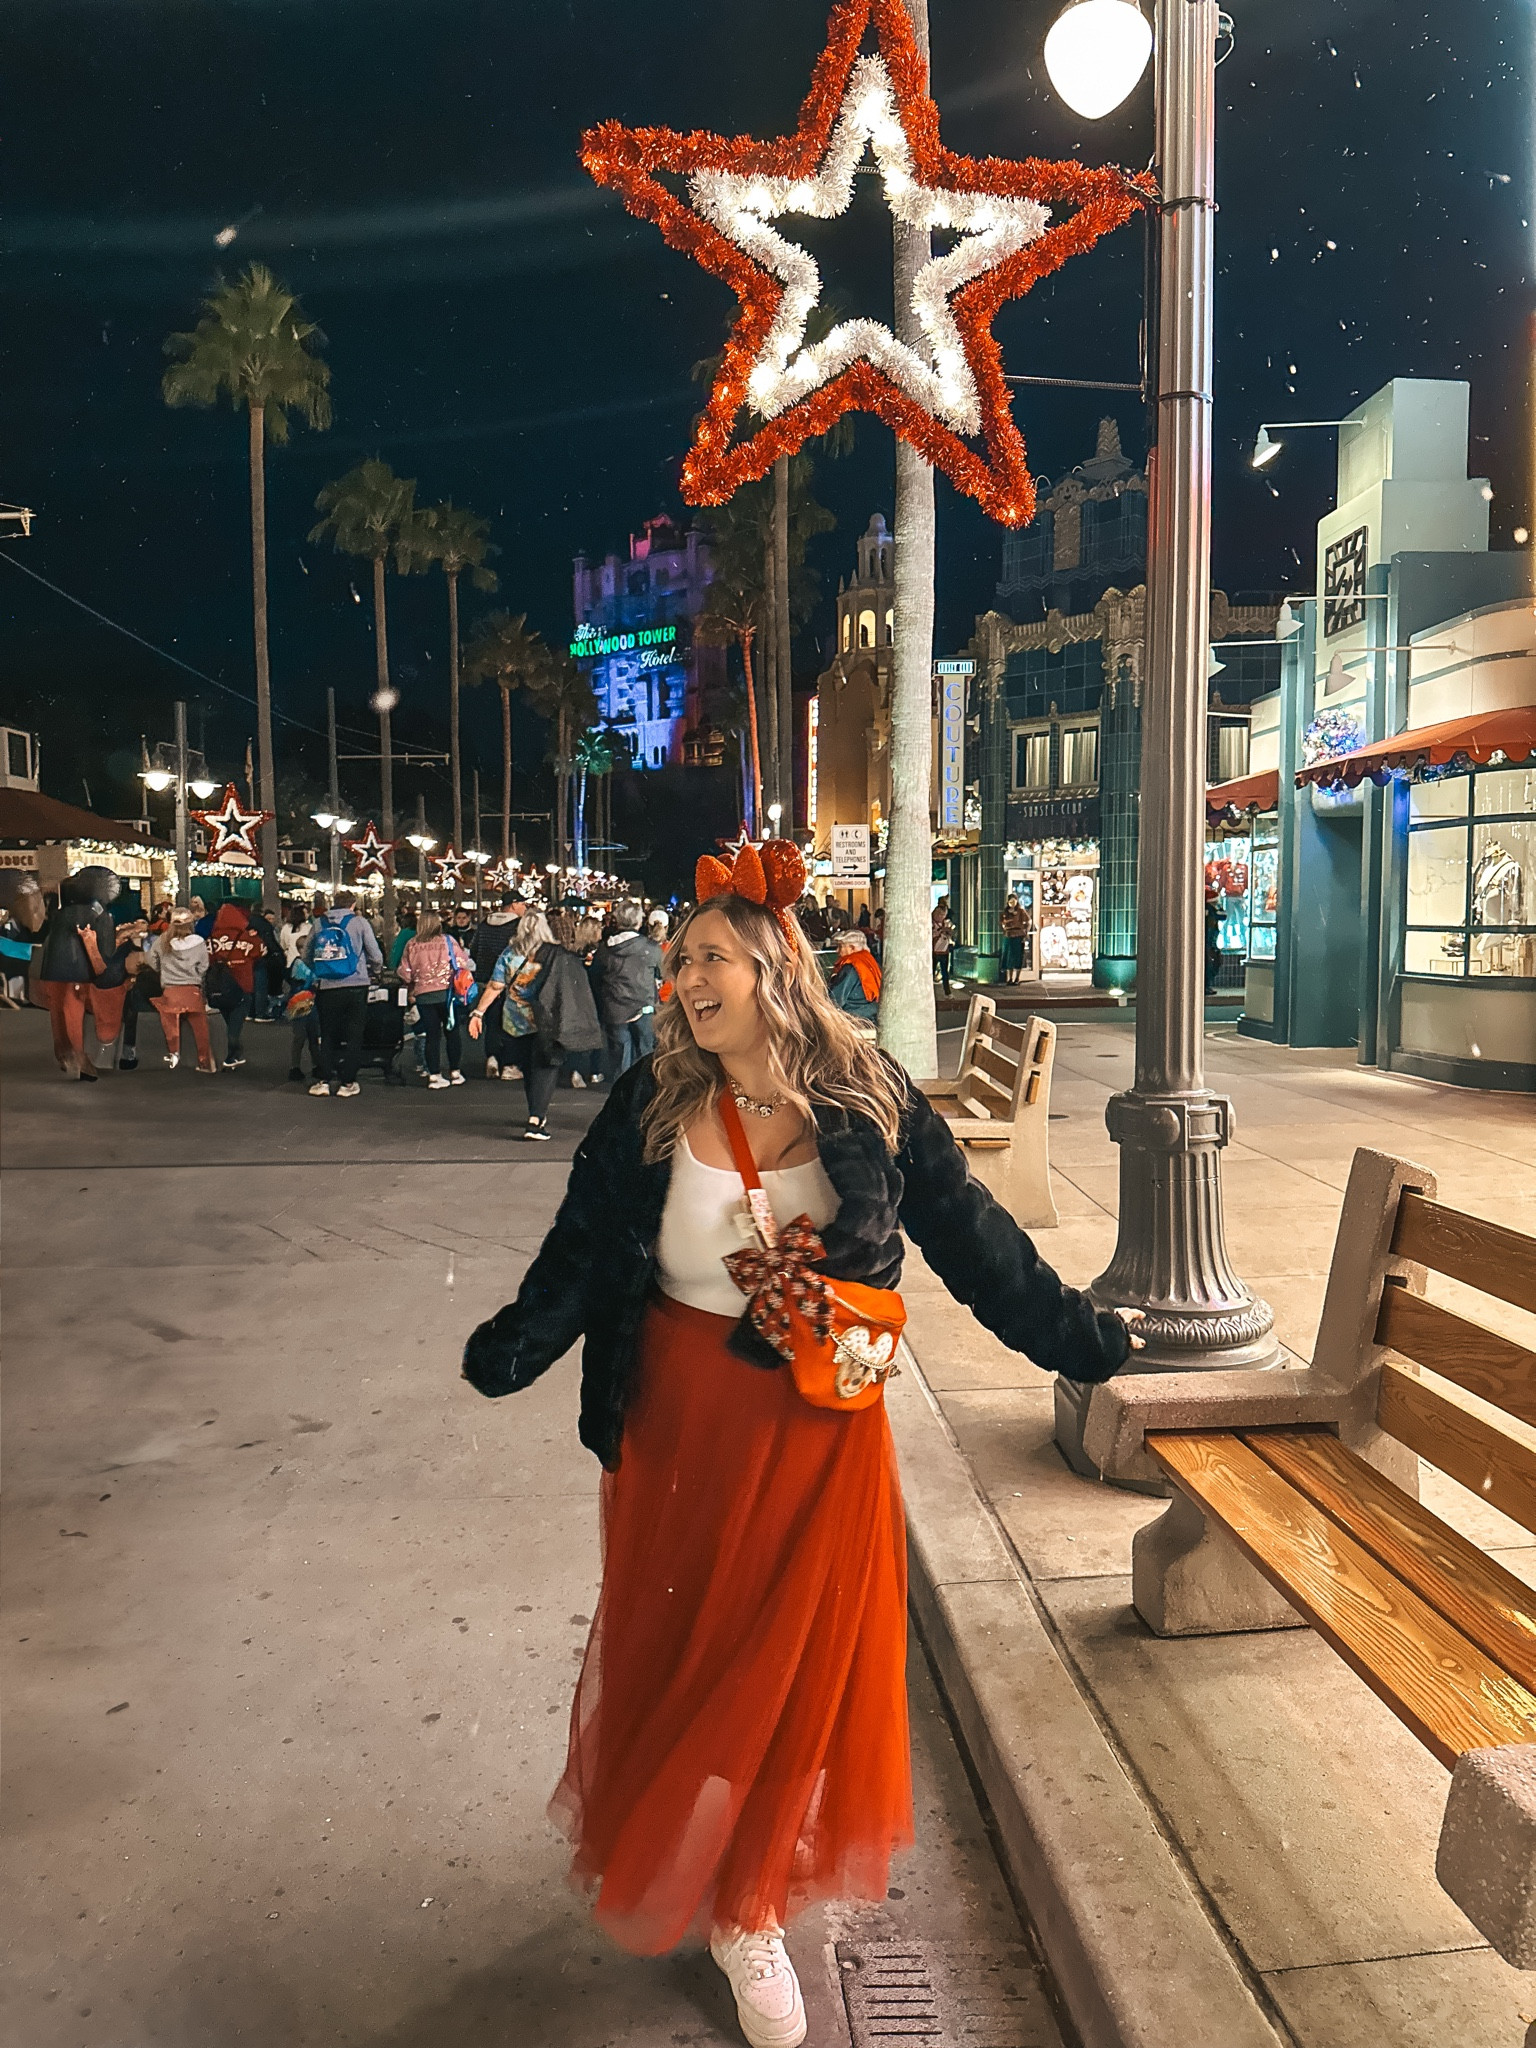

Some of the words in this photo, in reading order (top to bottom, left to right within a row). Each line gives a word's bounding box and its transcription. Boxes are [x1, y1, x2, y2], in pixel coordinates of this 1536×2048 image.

[569, 634, 636, 657] HOLLYWOOD
[638, 626, 676, 646] TOWER
[574, 623, 597, 642] The
[638, 646, 676, 669] Hotel
[945, 683, 962, 824] COUTURE
